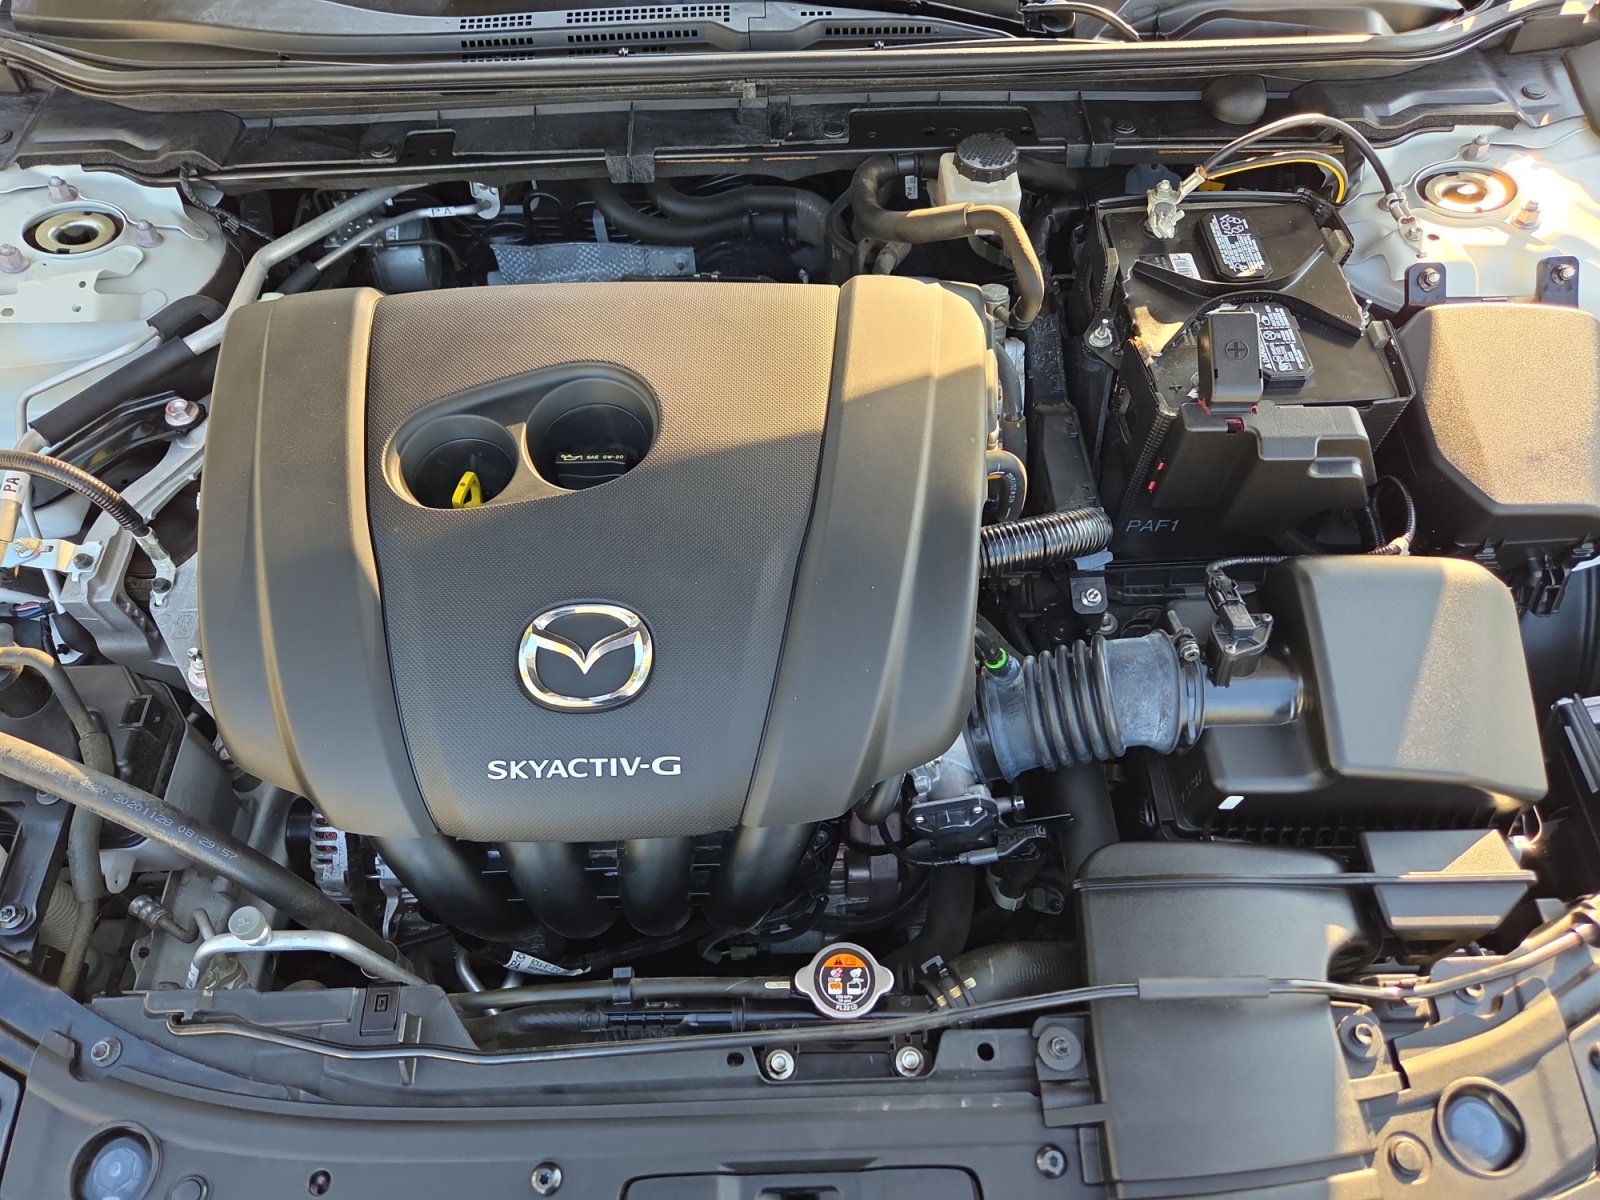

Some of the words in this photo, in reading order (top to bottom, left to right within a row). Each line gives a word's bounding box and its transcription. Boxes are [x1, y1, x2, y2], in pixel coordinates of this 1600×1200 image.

[3, 477, 20, 492] PA
[1125, 519, 1179, 532] PAF1
[487, 756, 682, 780] SKYACTIV-G
[113, 794, 174, 827] 20201128
[177, 825, 239, 860] 08:29:57
